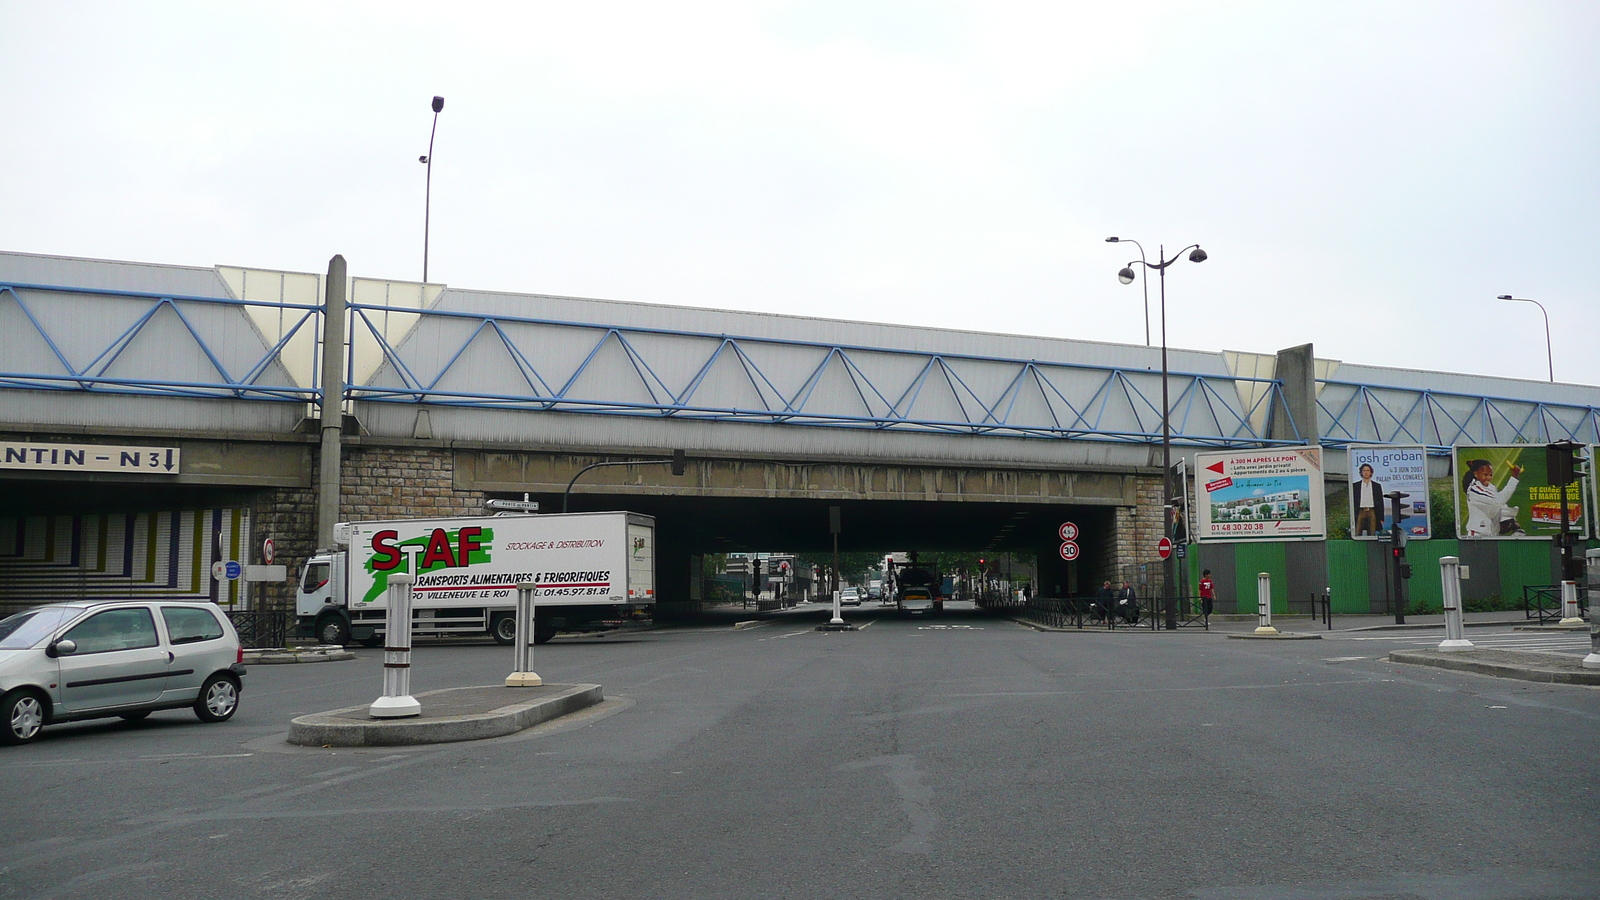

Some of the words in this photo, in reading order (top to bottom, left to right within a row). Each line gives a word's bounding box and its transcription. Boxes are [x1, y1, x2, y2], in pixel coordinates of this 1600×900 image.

[0, 447, 85, 466] NTIN
[120, 451, 140, 467] N
[148, 452, 160, 468] 3
[1355, 449, 1380, 467] josh
[1382, 450, 1423, 467] groban
[1233, 523, 1242, 531] 30
[505, 541, 547, 551] STOCKAGE
[547, 541, 554, 549] &
[556, 539, 604, 549] DISTRIBUTION
[1064, 546, 1075, 555] 30
[371, 526, 482, 582] STAF
[535, 572, 541, 583] &
[543, 570, 610, 583] FRIGORIFIQUES
[427, 591, 478, 599] VILLENEUVE
[479, 590, 491, 598] LE
[493, 590, 510, 598] ROI
[543, 587, 610, 597] 01.45.97.81.81
